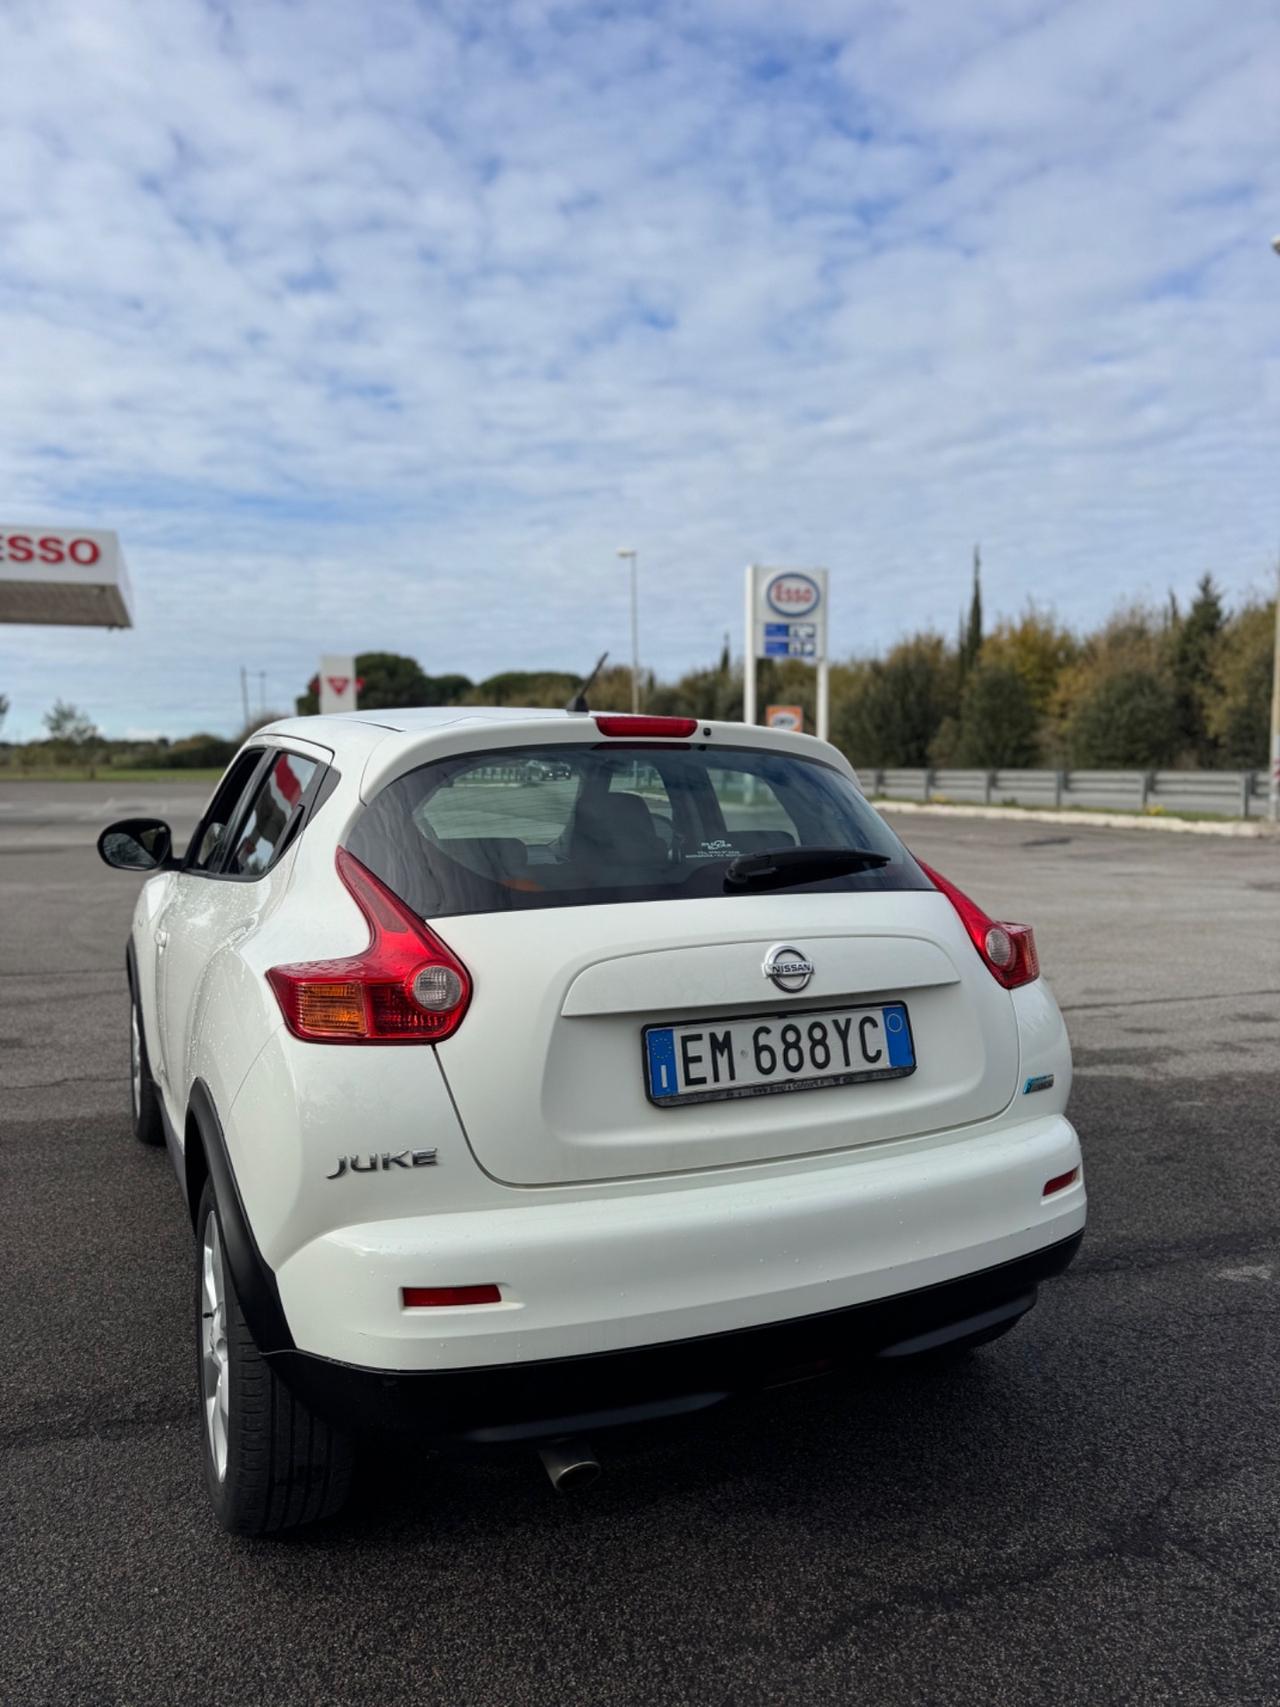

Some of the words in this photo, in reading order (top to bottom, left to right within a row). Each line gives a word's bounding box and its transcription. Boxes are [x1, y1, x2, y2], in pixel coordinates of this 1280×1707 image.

[0, 533, 101, 566] SSO
[773, 580, 813, 604] Esso
[772, 963, 811, 974] NISSAN
[680, 1030, 737, 1086] EM
[752, 1016, 883, 1076] 688YC
[326, 1147, 439, 1180] JUKE
